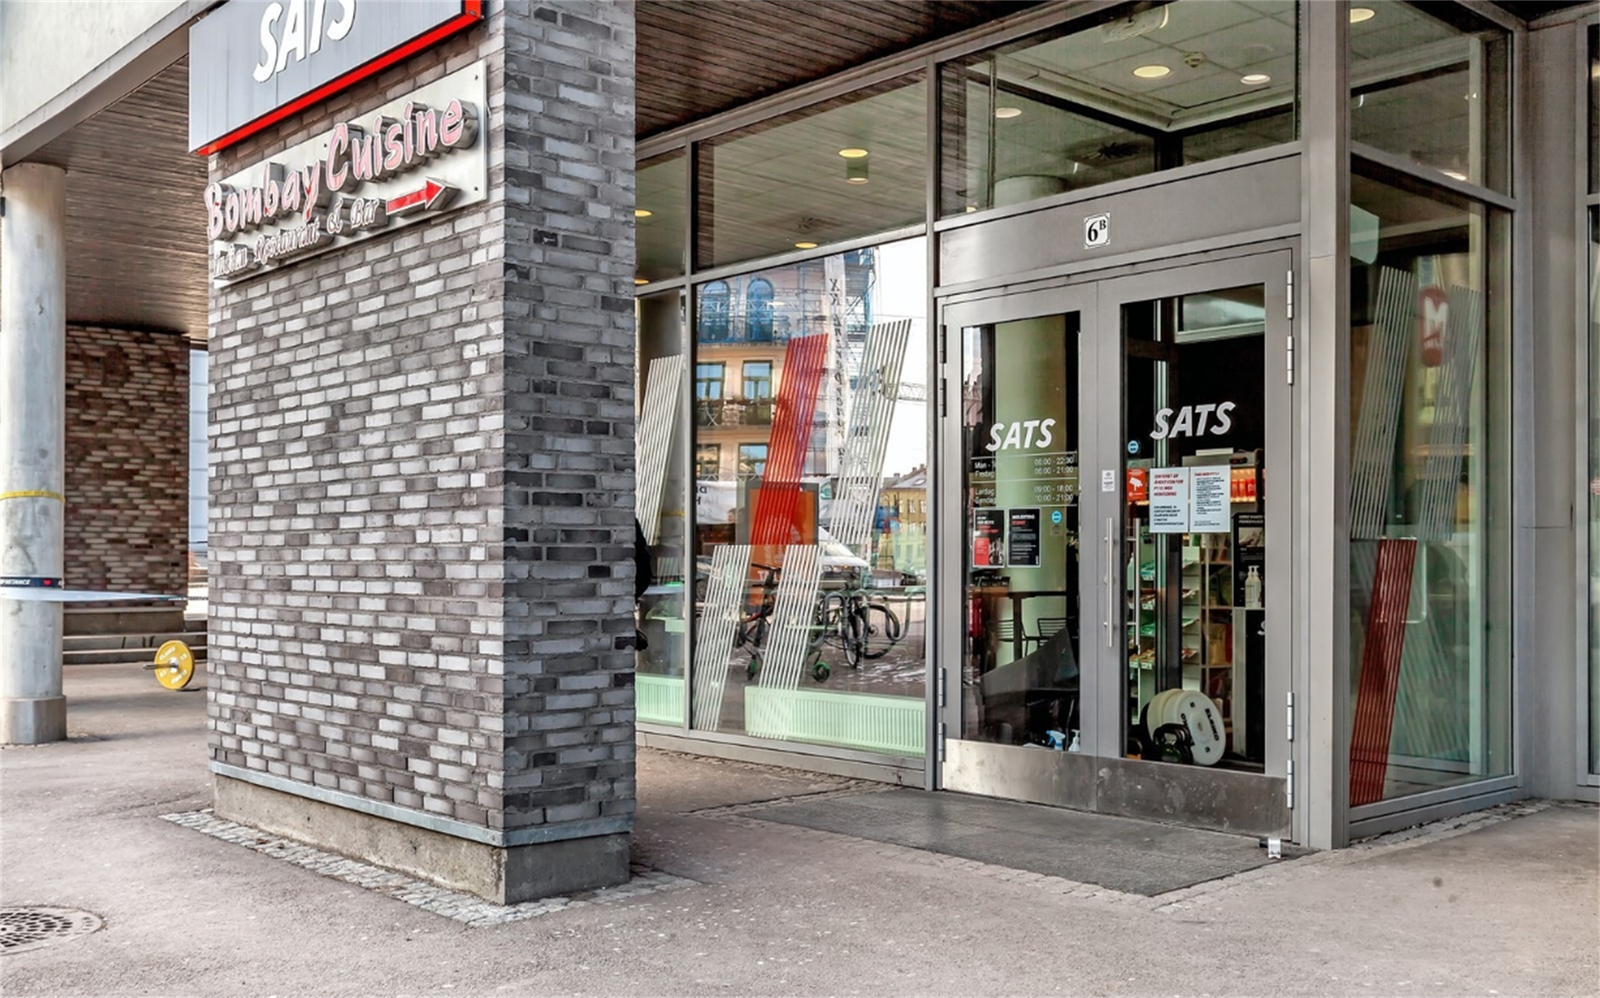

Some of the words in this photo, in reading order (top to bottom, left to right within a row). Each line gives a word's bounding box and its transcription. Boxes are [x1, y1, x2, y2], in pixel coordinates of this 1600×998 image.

[204, 160, 321, 241] Bombay
[326, 98, 464, 191] Cuisine
[254, 216, 321, 265] Restaurant
[986, 418, 1057, 452] SATS
[1150, 401, 1236, 440] SATS
[974, 471, 995, 479] Fredag
[1056, 466, 1074, 474] 21:00
